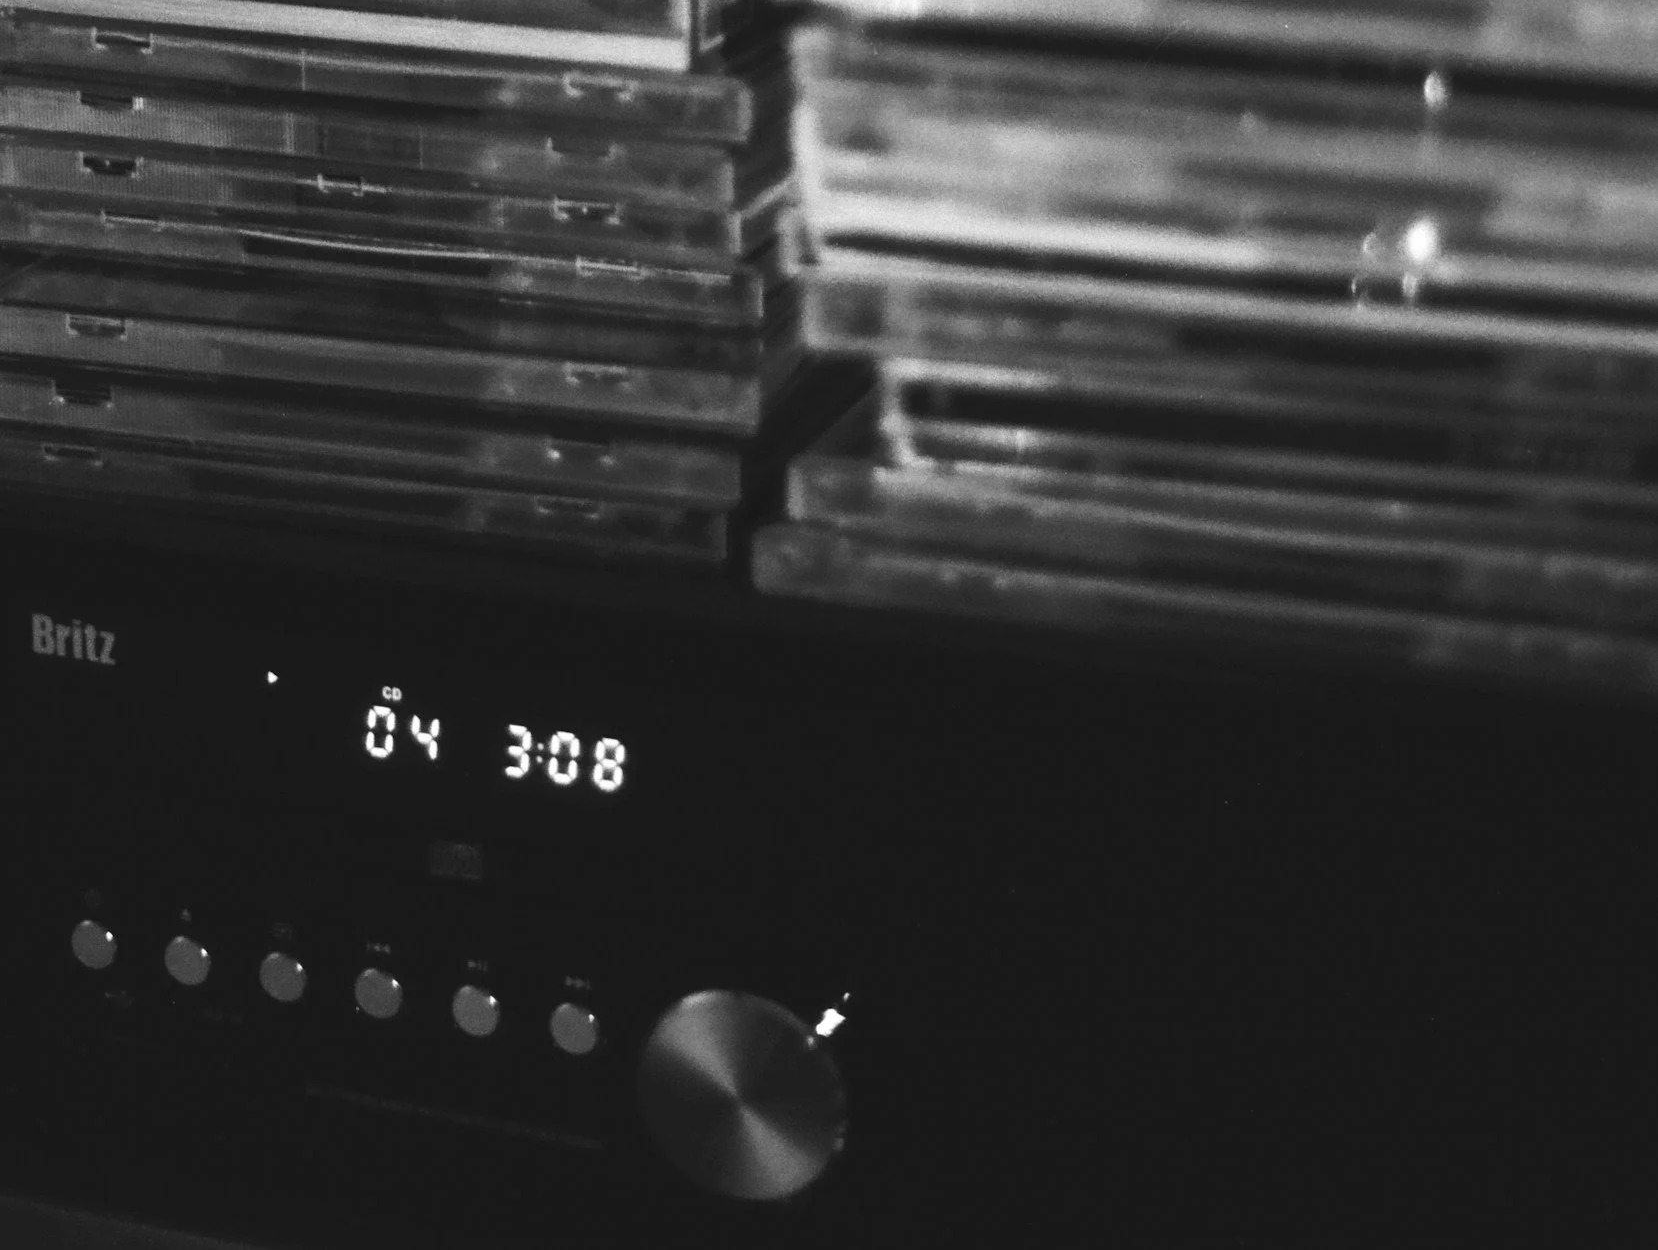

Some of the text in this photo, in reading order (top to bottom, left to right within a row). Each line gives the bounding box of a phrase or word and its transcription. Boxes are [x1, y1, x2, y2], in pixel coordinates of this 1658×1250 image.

[32, 613, 116, 666] Britz
[381, 686, 404, 701] CD
[365, 706, 627, 794] 04 3:08
